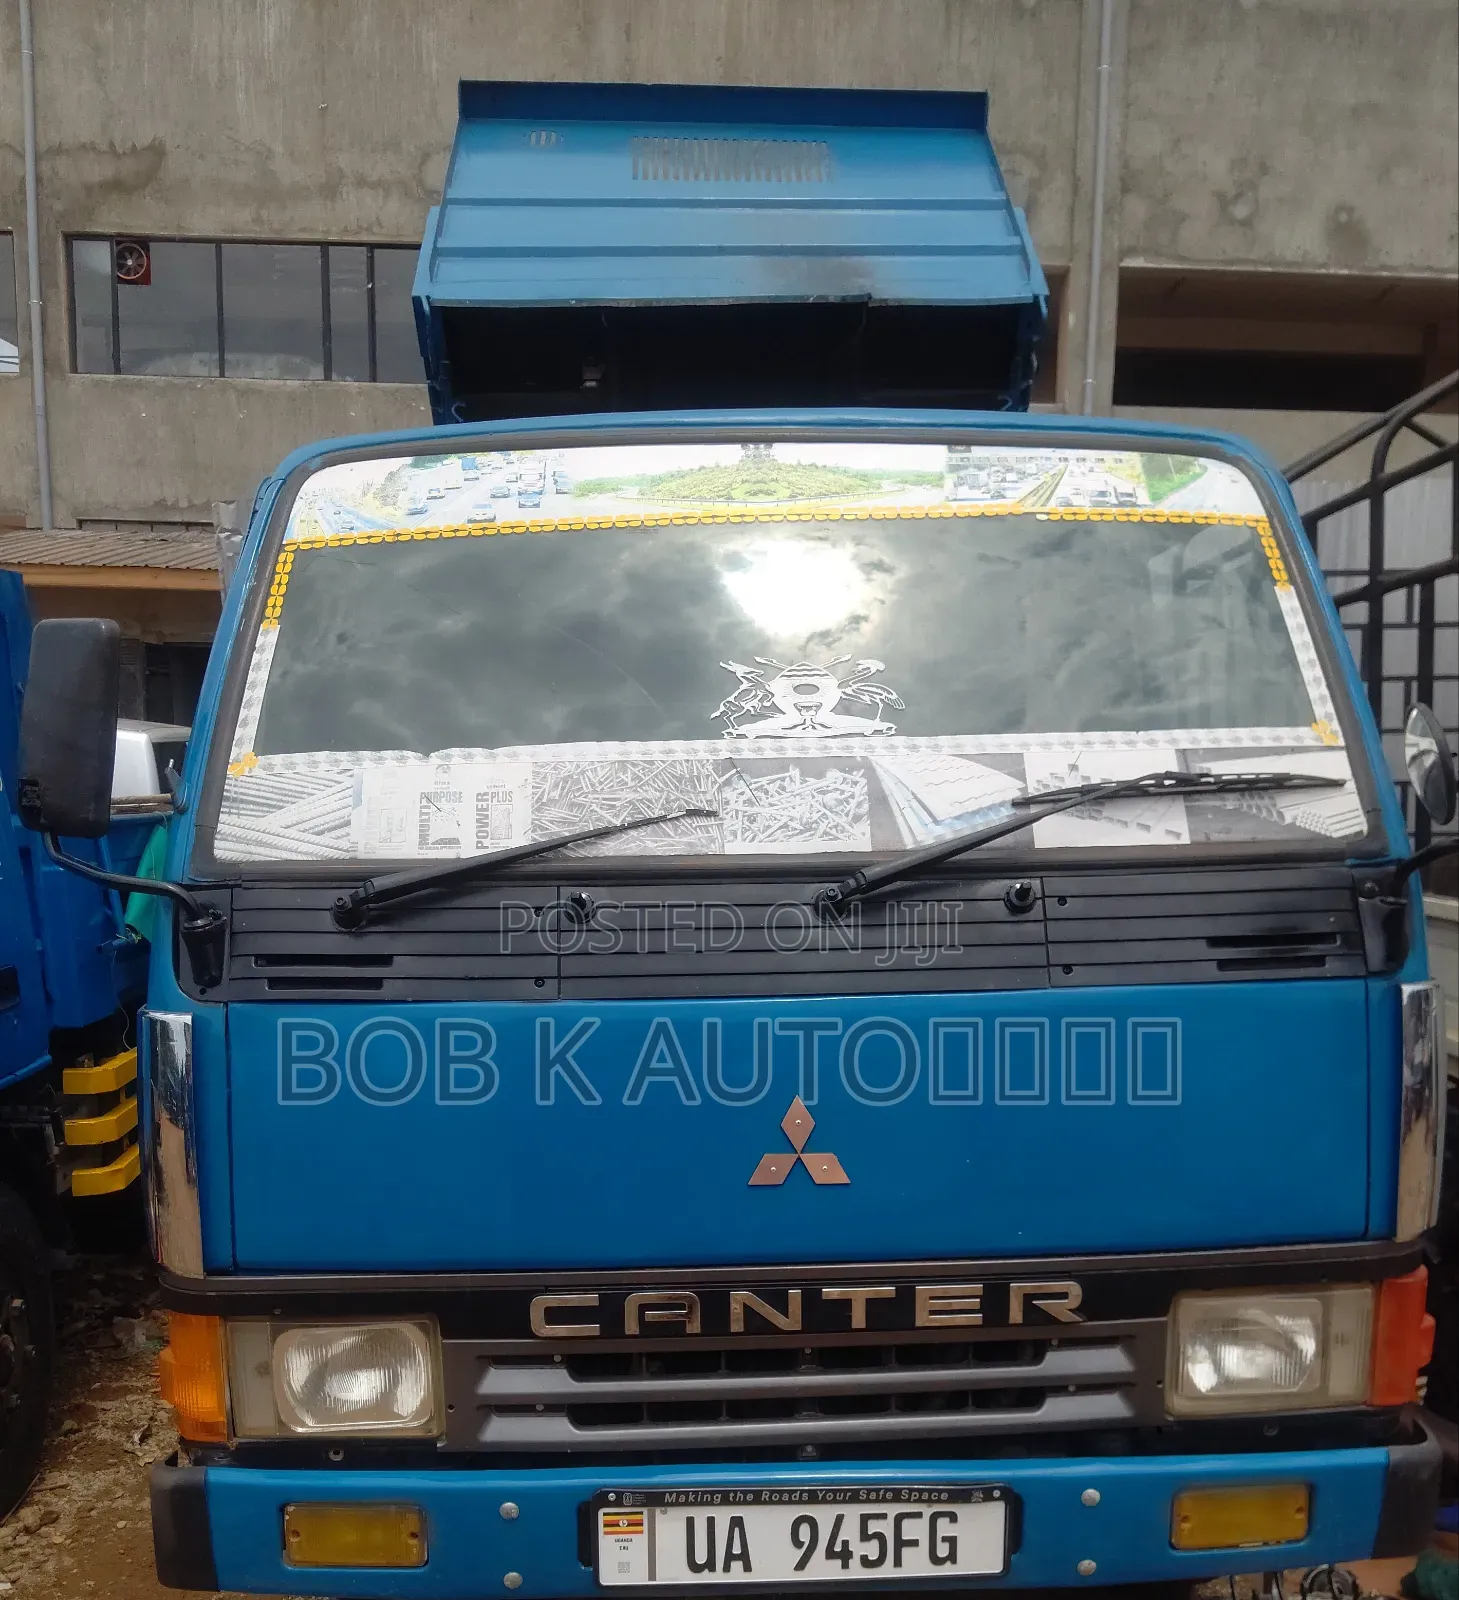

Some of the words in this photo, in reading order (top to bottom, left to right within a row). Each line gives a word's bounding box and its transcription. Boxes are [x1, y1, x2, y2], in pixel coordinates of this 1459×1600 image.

[420, 791, 464, 805] PURPOSE
[490, 790, 513, 804] PLUS
[418, 804, 432, 847] MULTI
[475, 791, 490, 850] POWER
[529, 1280, 1087, 1337] CANTER
[664, 1492, 722, 1505] Making
[729, 1491, 753, 1501] the
[761, 1490, 809, 1502] Roads
[817, 1490, 852, 1501] Your
[859, 1489, 894, 1500] Safe
[900, 1489, 949, 1502] Space
[685, 1514, 753, 1574] UA
[790, 1510, 959, 1572] 945FG
